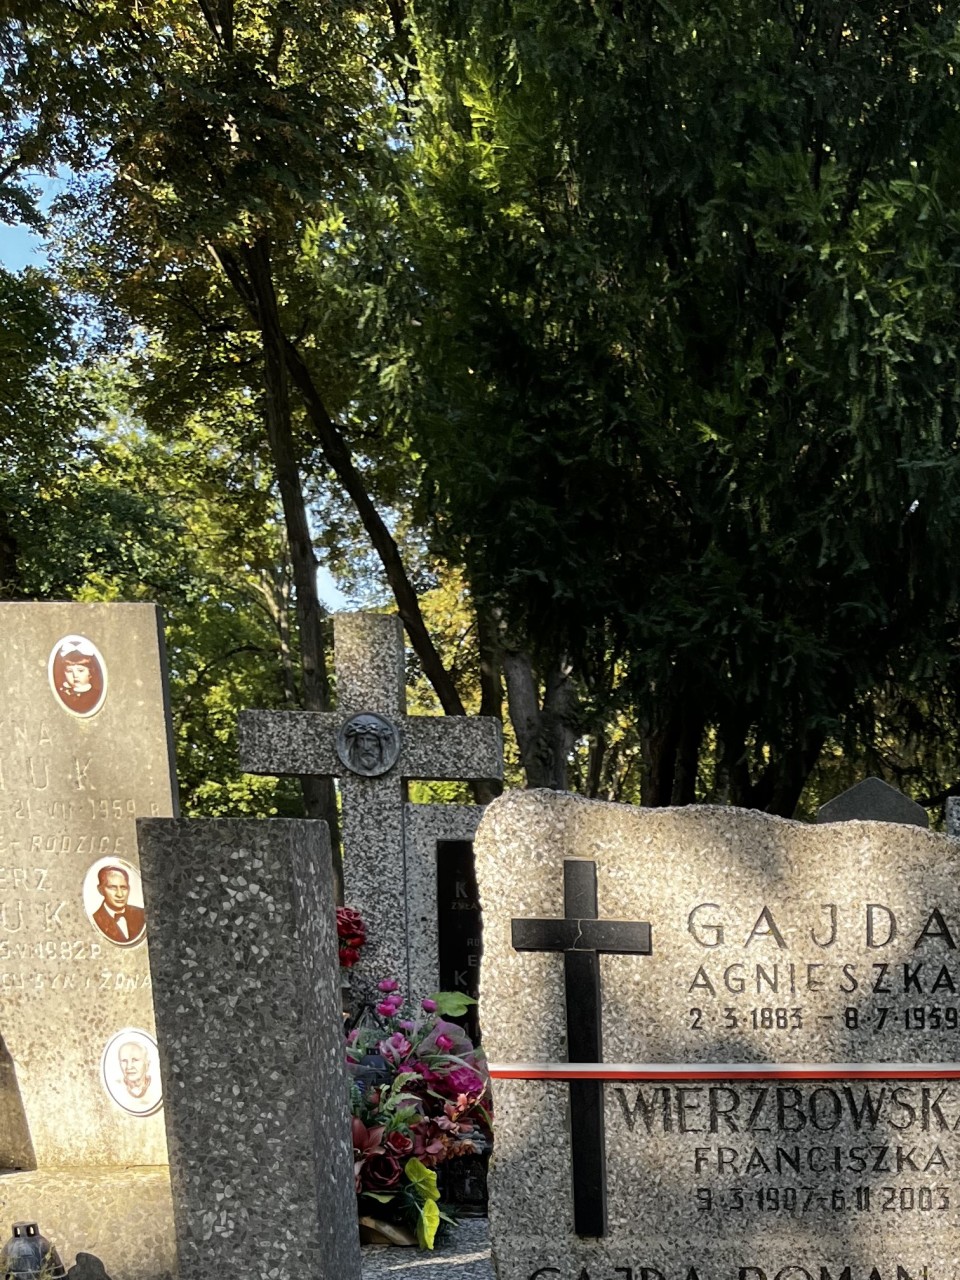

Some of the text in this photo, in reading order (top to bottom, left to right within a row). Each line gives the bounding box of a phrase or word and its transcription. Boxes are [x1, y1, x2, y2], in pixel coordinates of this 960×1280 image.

[687, 902, 957, 949] GAJDA
[688, 962, 957, 995] AGNIESZKA
[694, 1146, 950, 1175] FRANCISZKA
